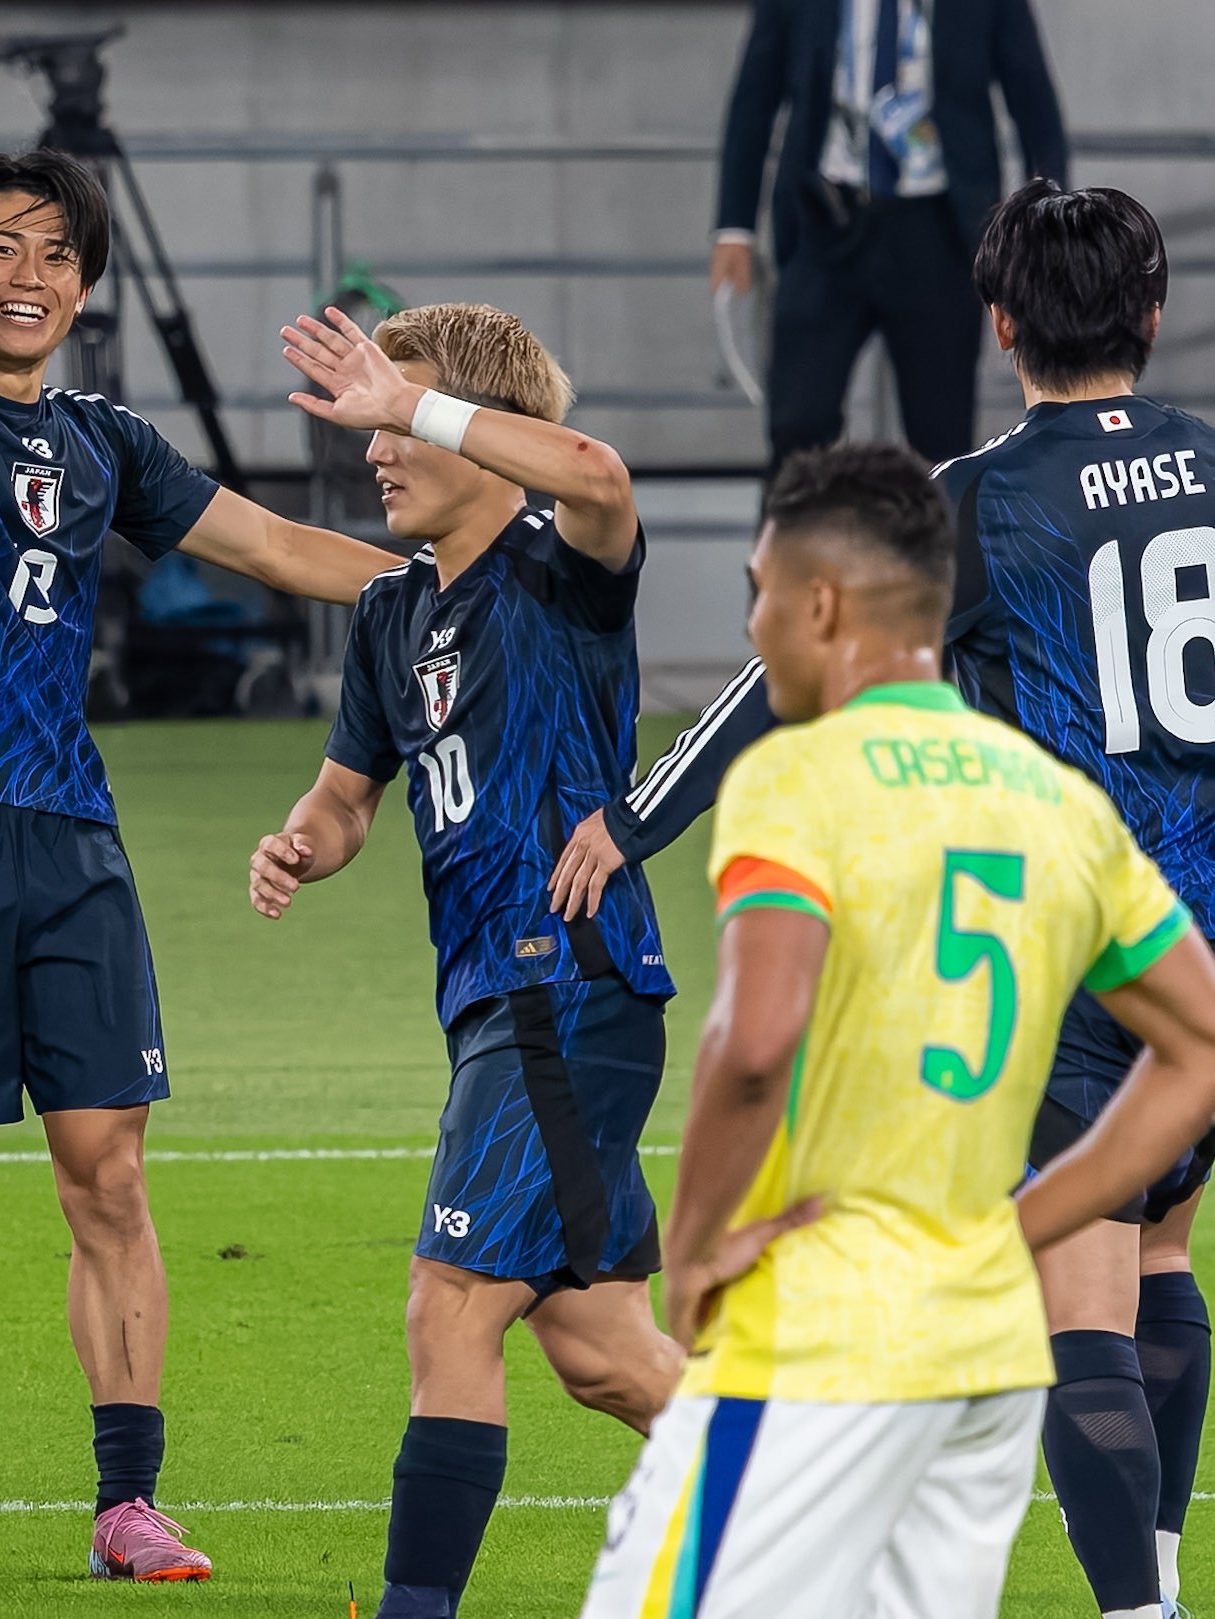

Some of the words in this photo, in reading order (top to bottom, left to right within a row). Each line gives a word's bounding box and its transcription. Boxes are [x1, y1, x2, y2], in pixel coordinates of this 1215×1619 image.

[25, 467, 52, 476] JAPAN
[1079, 450, 1207, 510] AYASE
[1088, 526, 1215, 755] 18
[418, 734, 476, 833] 10
[920, 847, 1027, 1105] 5
[141, 1049, 164, 1075] Y-3
[433, 1204, 471, 1238] Y-3
